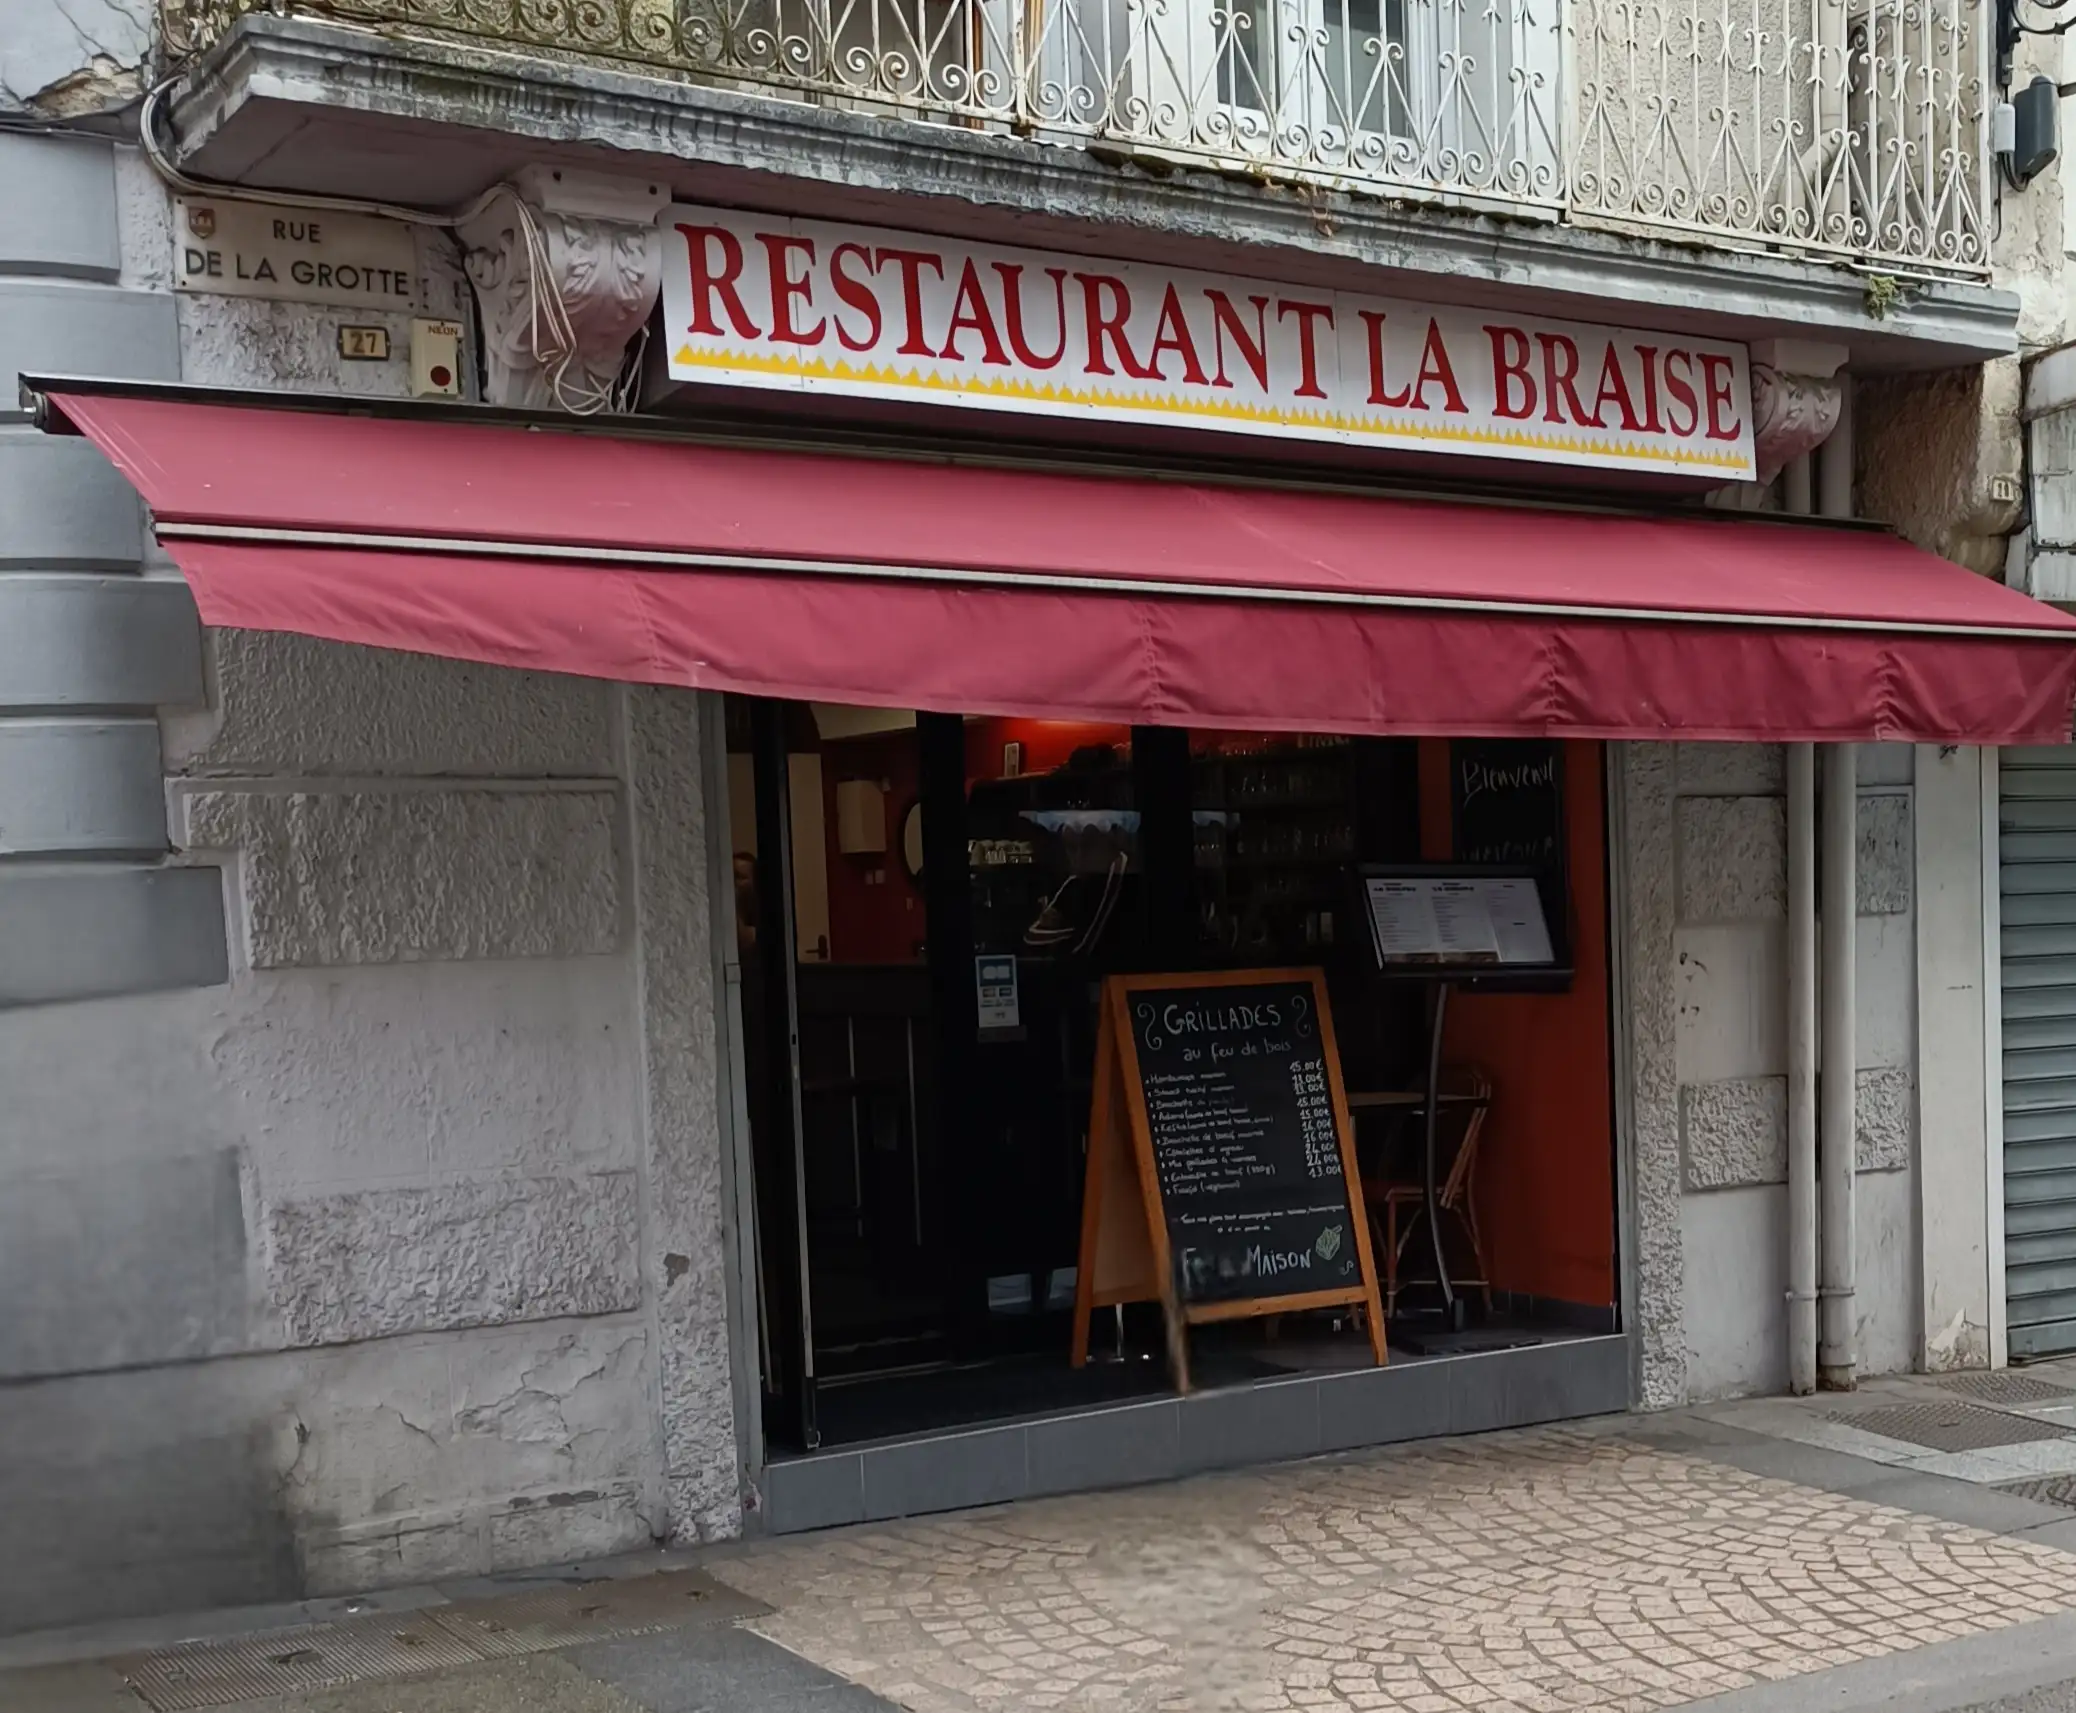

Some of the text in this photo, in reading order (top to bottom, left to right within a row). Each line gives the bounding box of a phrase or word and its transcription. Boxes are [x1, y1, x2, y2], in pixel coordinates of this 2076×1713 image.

[272, 219, 322, 244] RUE
[184, 249, 410, 296] DE LA GROTTE
[350, 331, 378, 354] 27
[675, 222, 1742, 442] RESTAURANT LA BRAISE
[1182, 1036, 1292, 1064] au feu de bois
